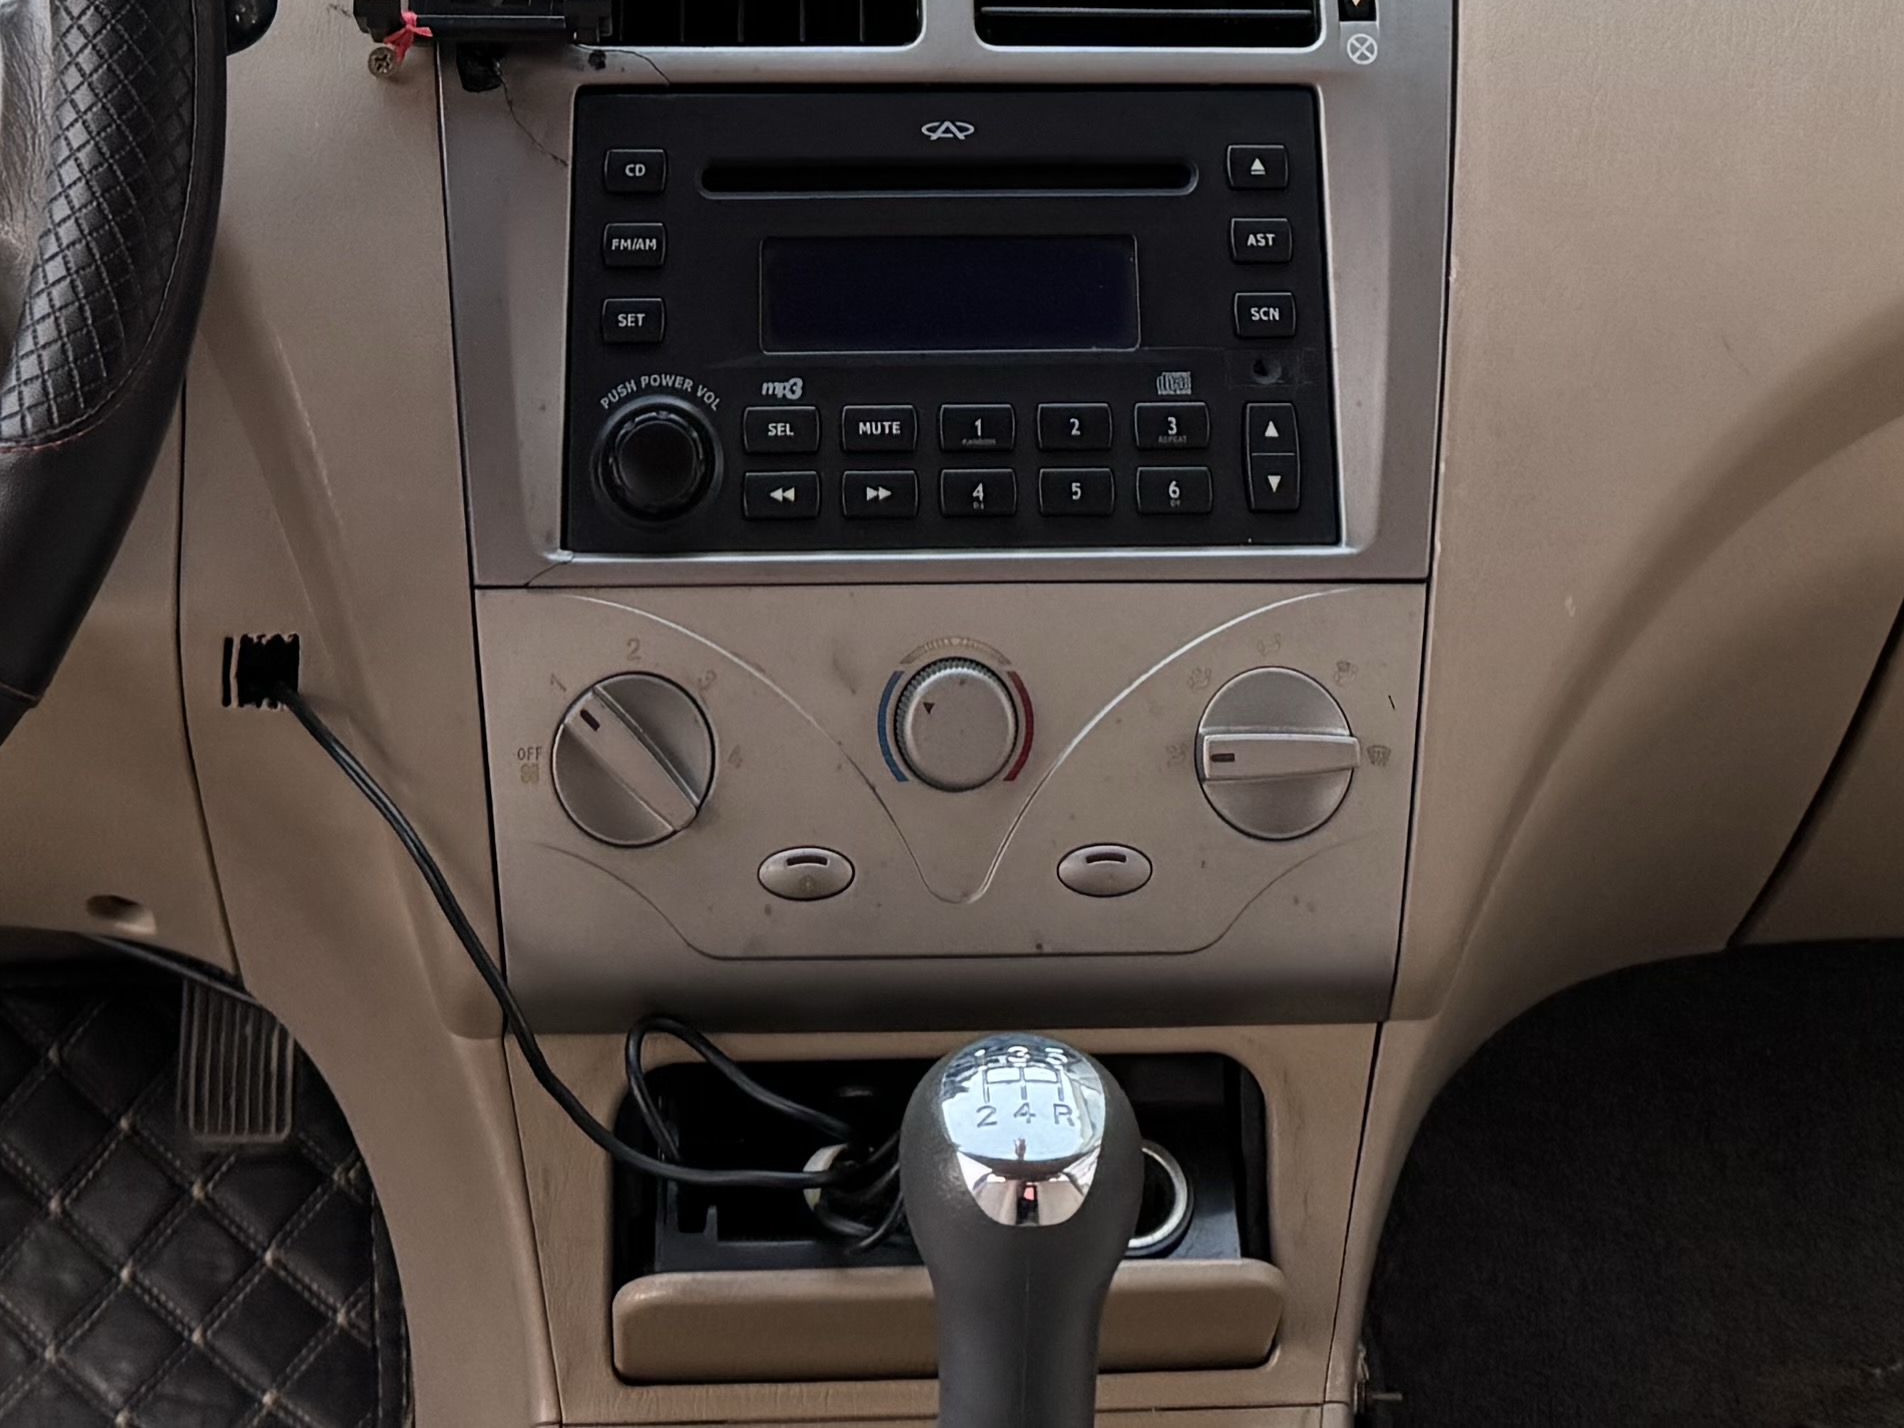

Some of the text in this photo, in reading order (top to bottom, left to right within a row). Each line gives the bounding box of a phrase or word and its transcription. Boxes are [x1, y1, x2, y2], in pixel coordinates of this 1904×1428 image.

[624, 163, 646, 177] CD
[611, 238, 657, 251] FM/AM
[1247, 233, 1276, 247] AST
[617, 313, 646, 327] SET
[1250, 307, 1280, 321] SCN
[600, 373, 722, 412] PUSH POWER VOL
[767, 422, 795, 437] SEL
[858, 421, 901, 435] MUTE
[974, 417, 983, 437] 1
[1069, 418, 1081, 436] 2
[1167, 416, 1178, 435] 3
[972, 482, 984, 501] 4
[1071, 482, 1082, 500] 5
[1168, 480, 1180, 499] 6
[625, 637, 643, 662] 2
[516, 746, 543, 762] OFF
[1007, 1045, 1031, 1065] 3
[976, 1101, 1076, 1128] 2 4 R
